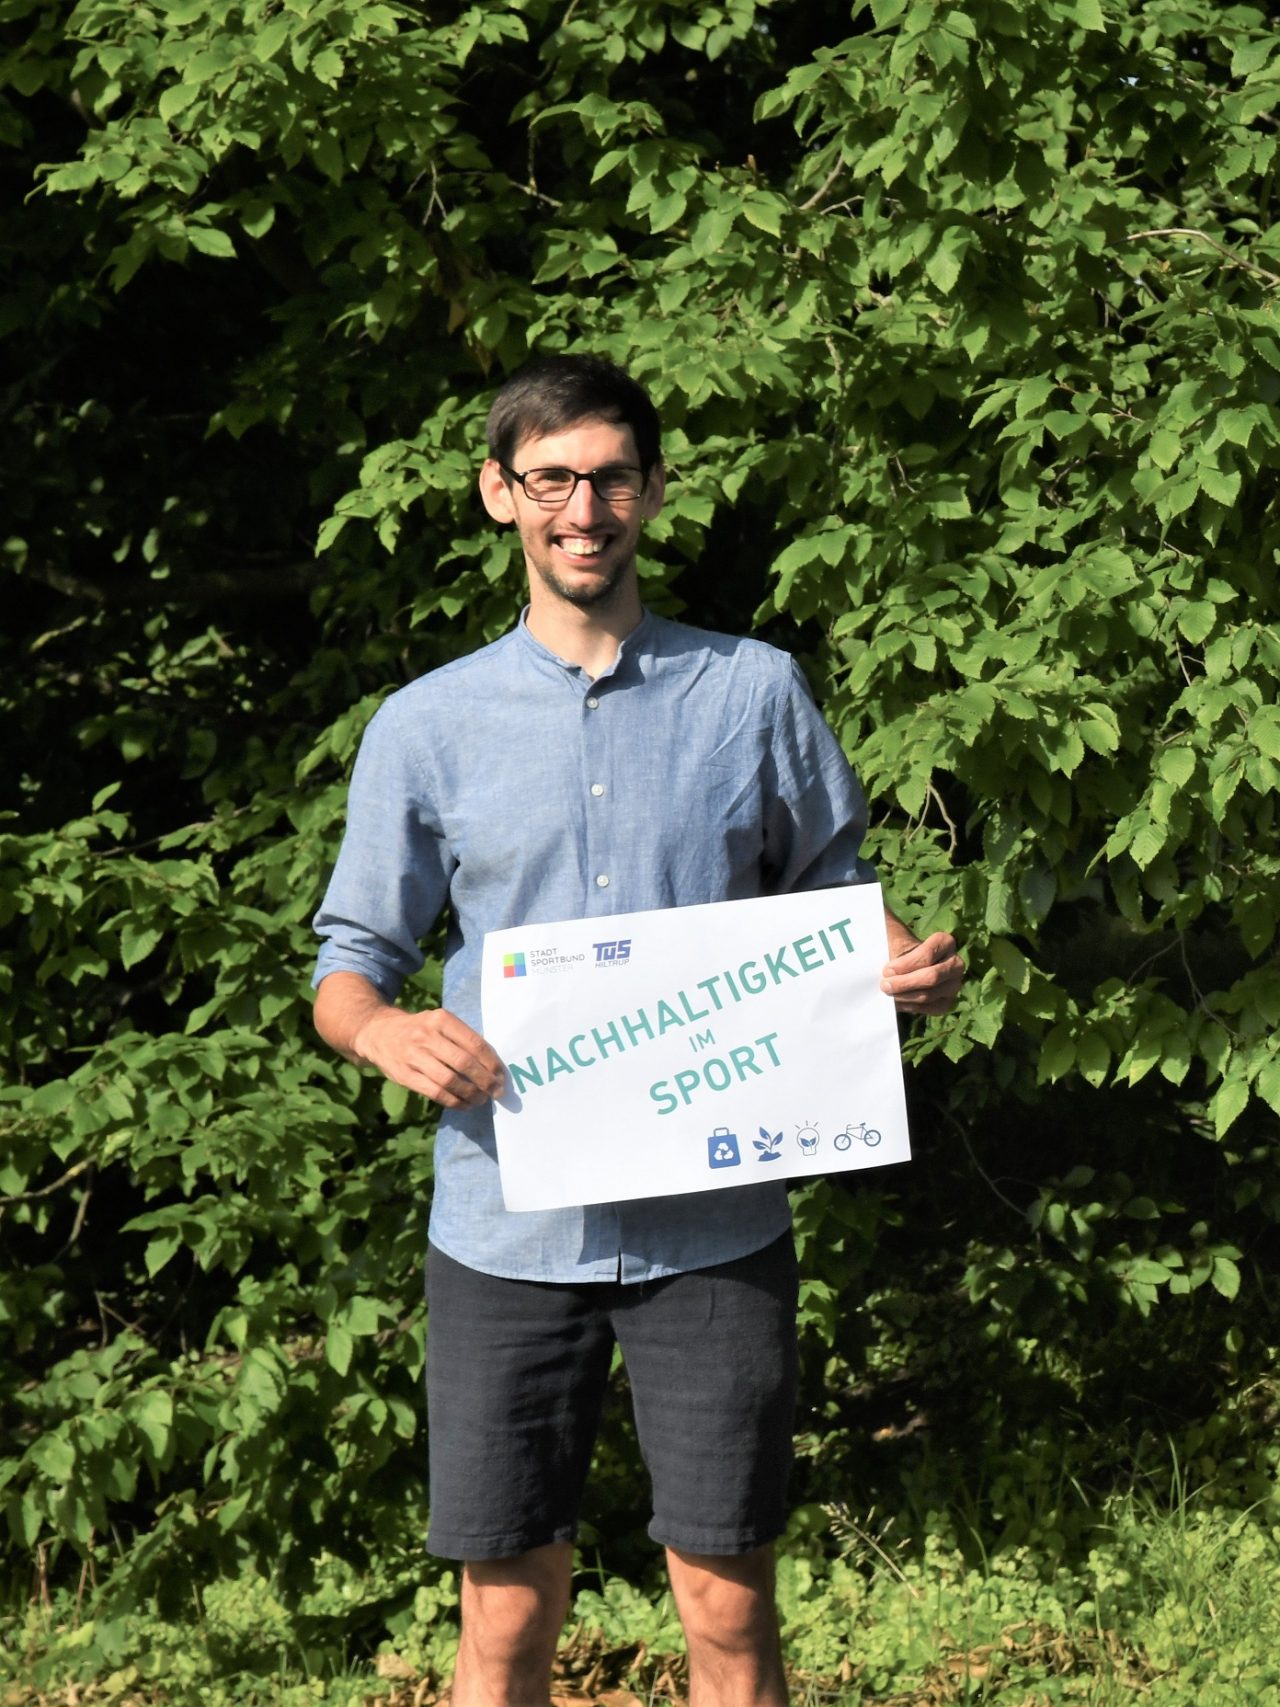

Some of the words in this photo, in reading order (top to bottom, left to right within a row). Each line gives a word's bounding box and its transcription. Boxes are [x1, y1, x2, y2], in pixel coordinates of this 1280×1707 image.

[530, 948, 558, 958] STADT
[531, 954, 586, 967] SPORTBUND
[595, 959, 630, 968] HILTRUP
[509, 918, 856, 1094] NACHHALTIGKEIT
[688, 1029, 716, 1053] IM
[649, 1032, 782, 1115] SPORT
